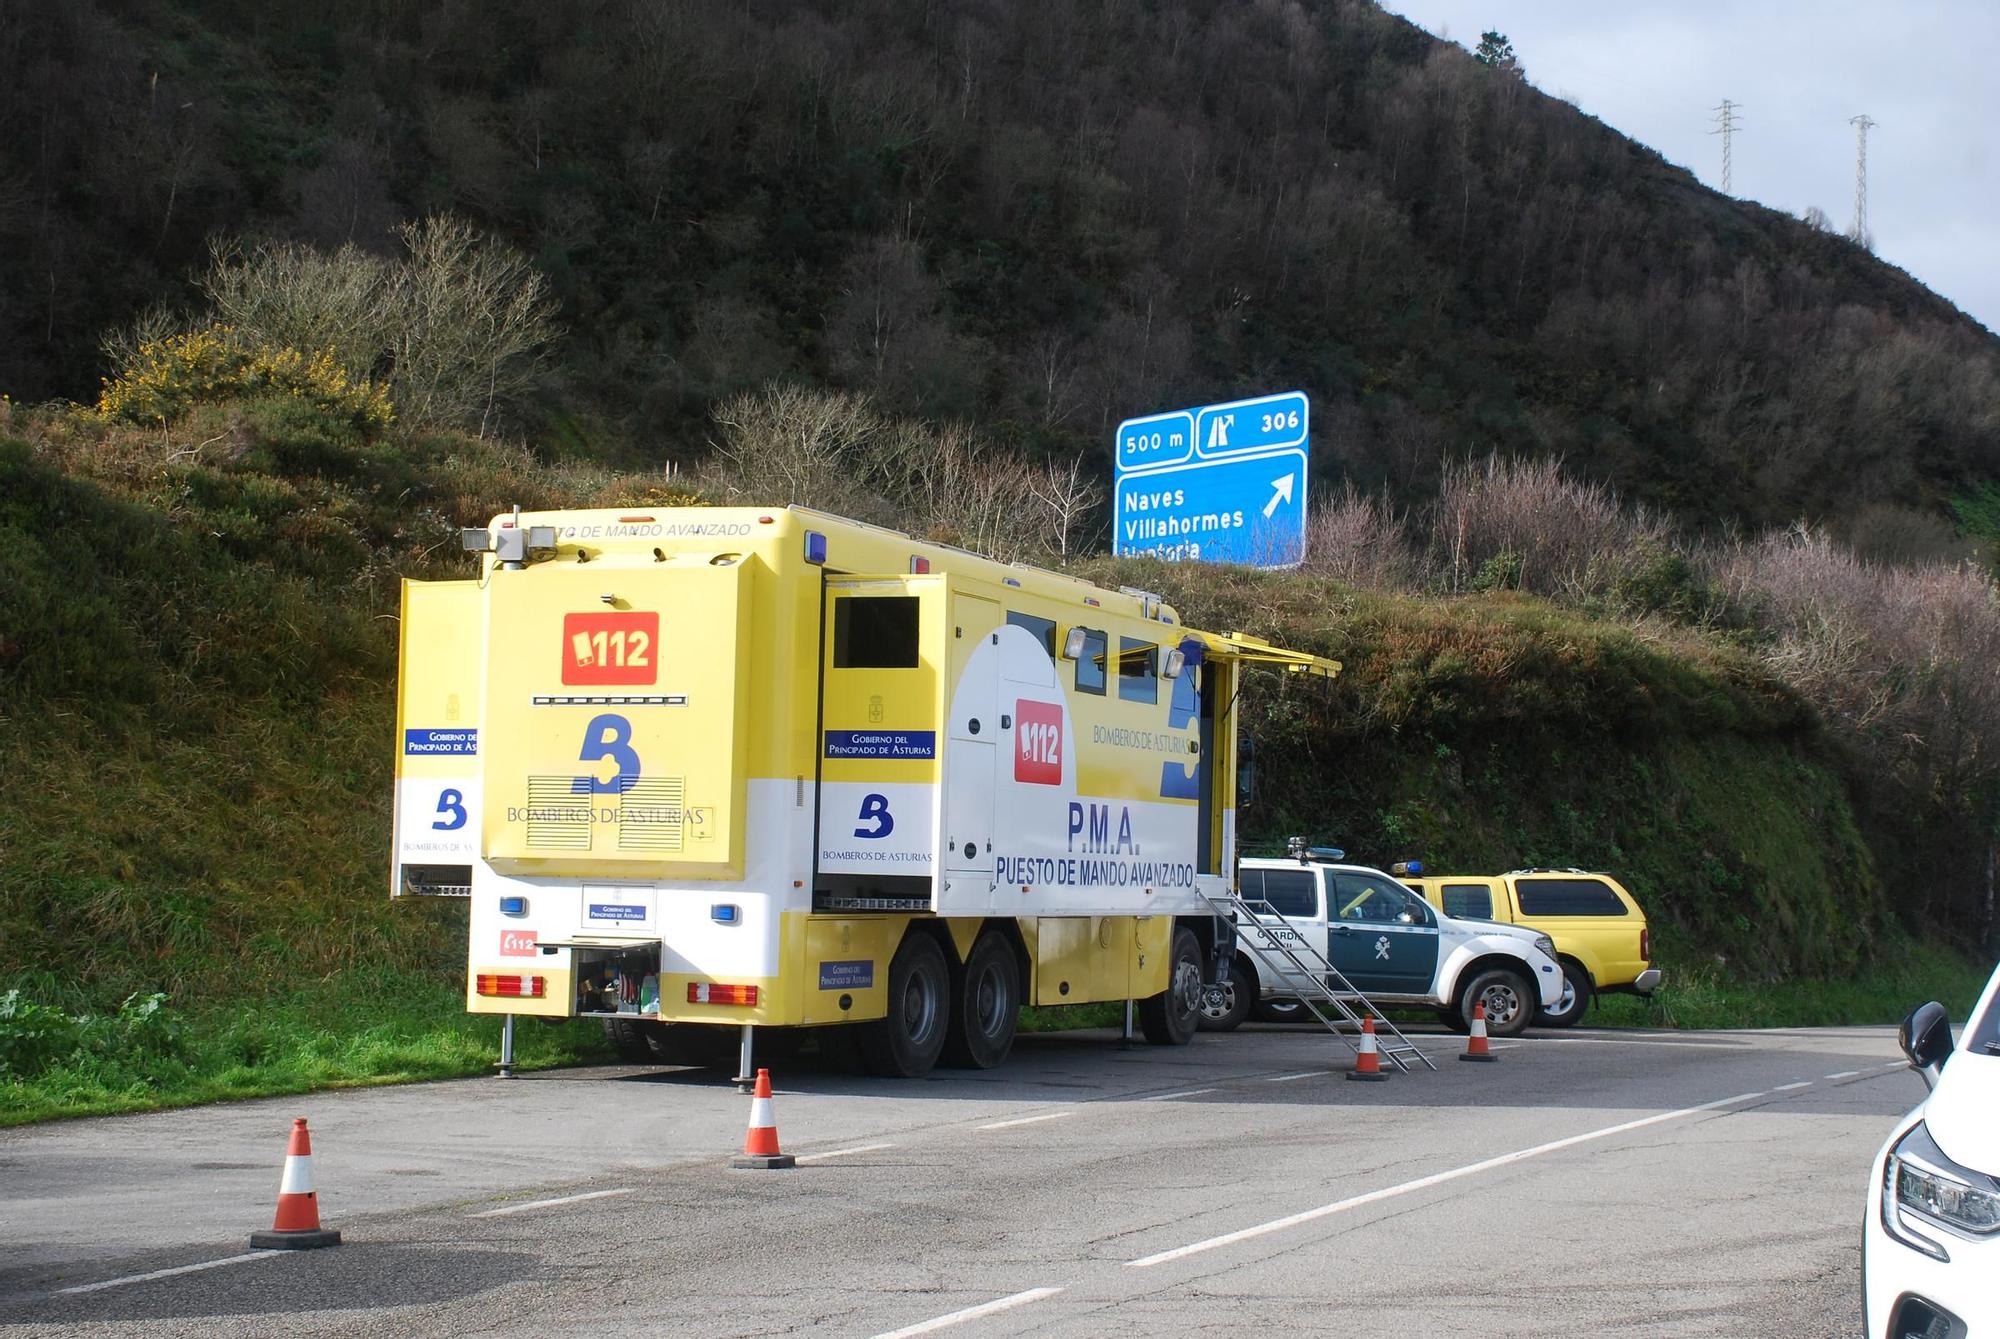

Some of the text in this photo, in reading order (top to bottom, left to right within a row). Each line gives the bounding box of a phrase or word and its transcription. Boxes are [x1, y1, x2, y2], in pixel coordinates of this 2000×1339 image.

[1261, 411, 1299, 432] 306
[1126, 433, 1183, 453] 500 m
[1125, 489, 1184, 513] Naves
[580, 525, 602, 538] DE
[605, 524, 663, 538] MANDO
[666, 523, 751, 536] AVANZADO
[1125, 510, 1244, 541] Villahormes
[592, 630, 649, 667] 112
[429, 731, 477, 742] GOBIERNO DE
[852, 734, 908, 744] GOBIERNO DEL
[1030, 722, 1059, 765] 112
[1093, 725, 1190, 755] BOMBEROS DE ASTURIAS
[409, 742, 451, 752] PRINCIPADO
[453, 743, 463, 752] DE
[829, 745, 931, 755] PRINCIPADO DE ASTURIAS
[507, 807, 704, 825] BOMBEROS DE ASTURIAS
[1068, 802, 1141, 856] P.M.A.
[403, 842, 449, 852] BOMBEROS
[450, 842, 461, 852] DE
[822, 850, 932, 862] BOMBEROS DE ASTURIAS
[996, 856, 1193, 888] PUESTO DE MANDO AVANZADO
[511, 939, 534, 950] 112
